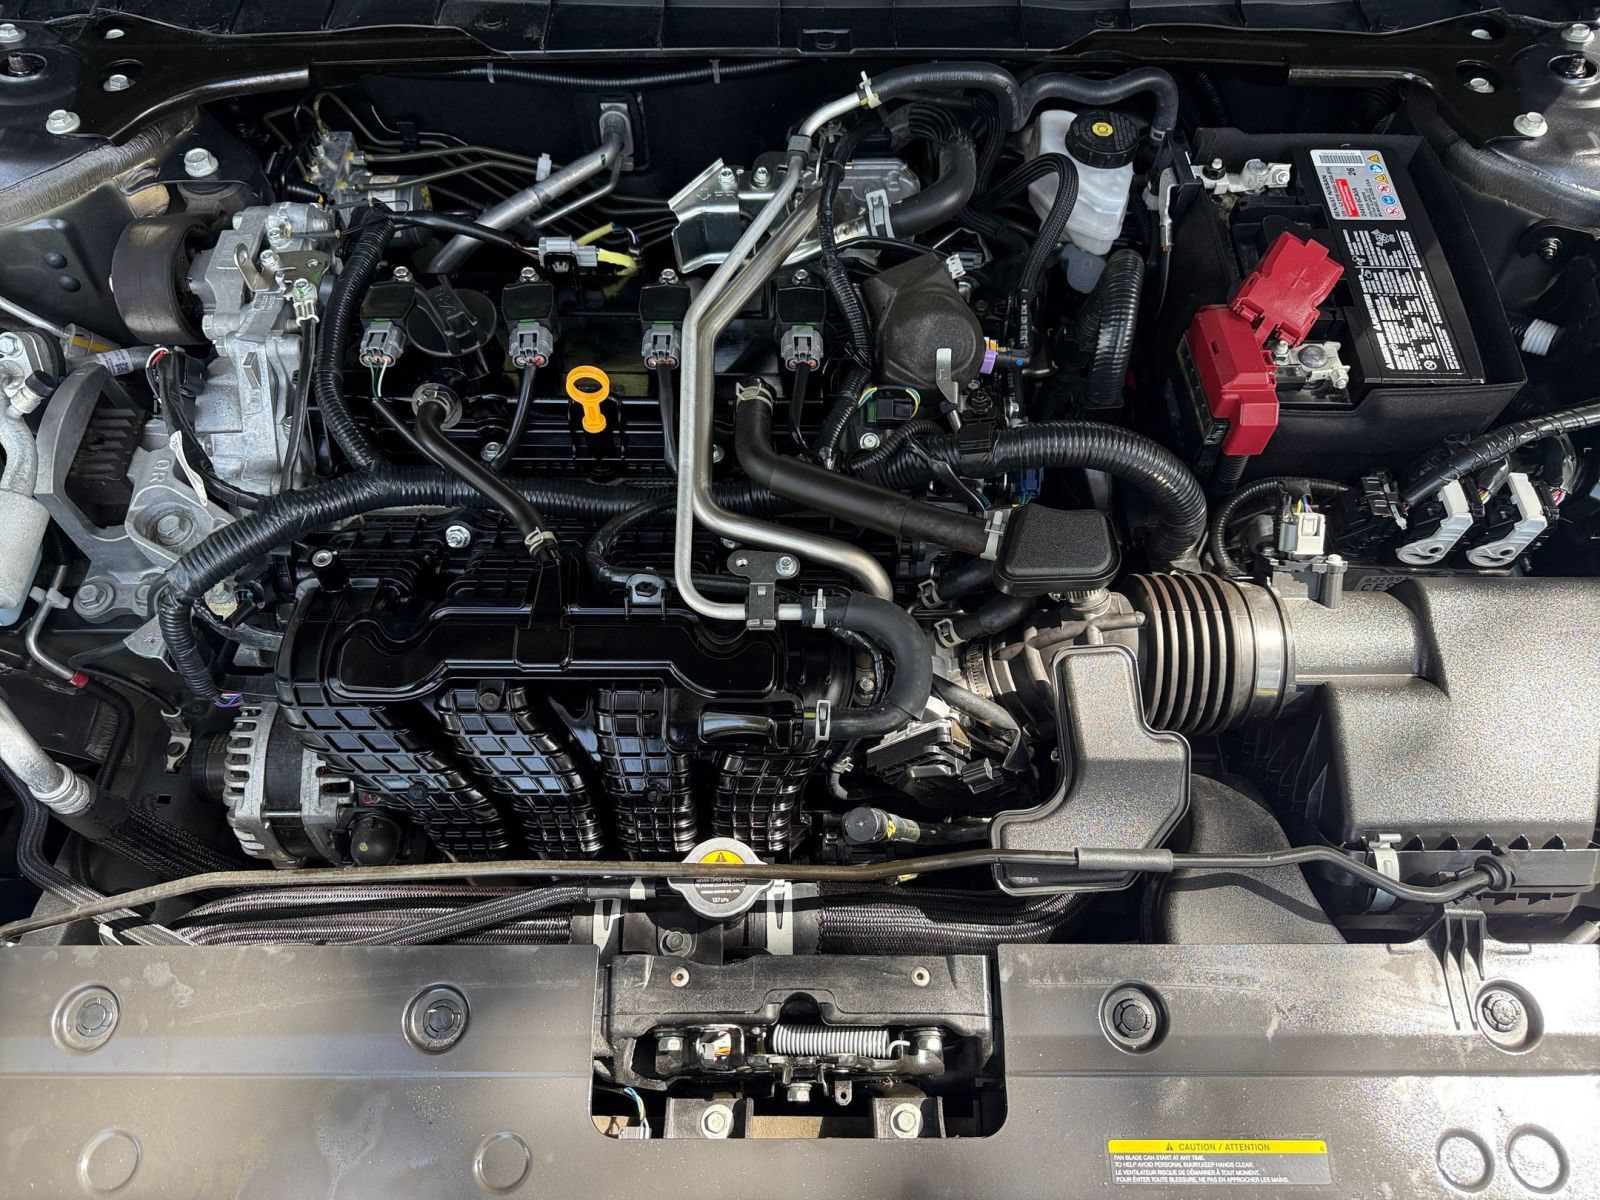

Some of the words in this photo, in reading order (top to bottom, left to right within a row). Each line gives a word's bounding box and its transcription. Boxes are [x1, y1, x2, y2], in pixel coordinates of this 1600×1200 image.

[1346, 168, 1356, 176] 26
[1322, 174, 1332, 196] NISSAN
[1178, 1143, 1216, 1151] CAUTION
